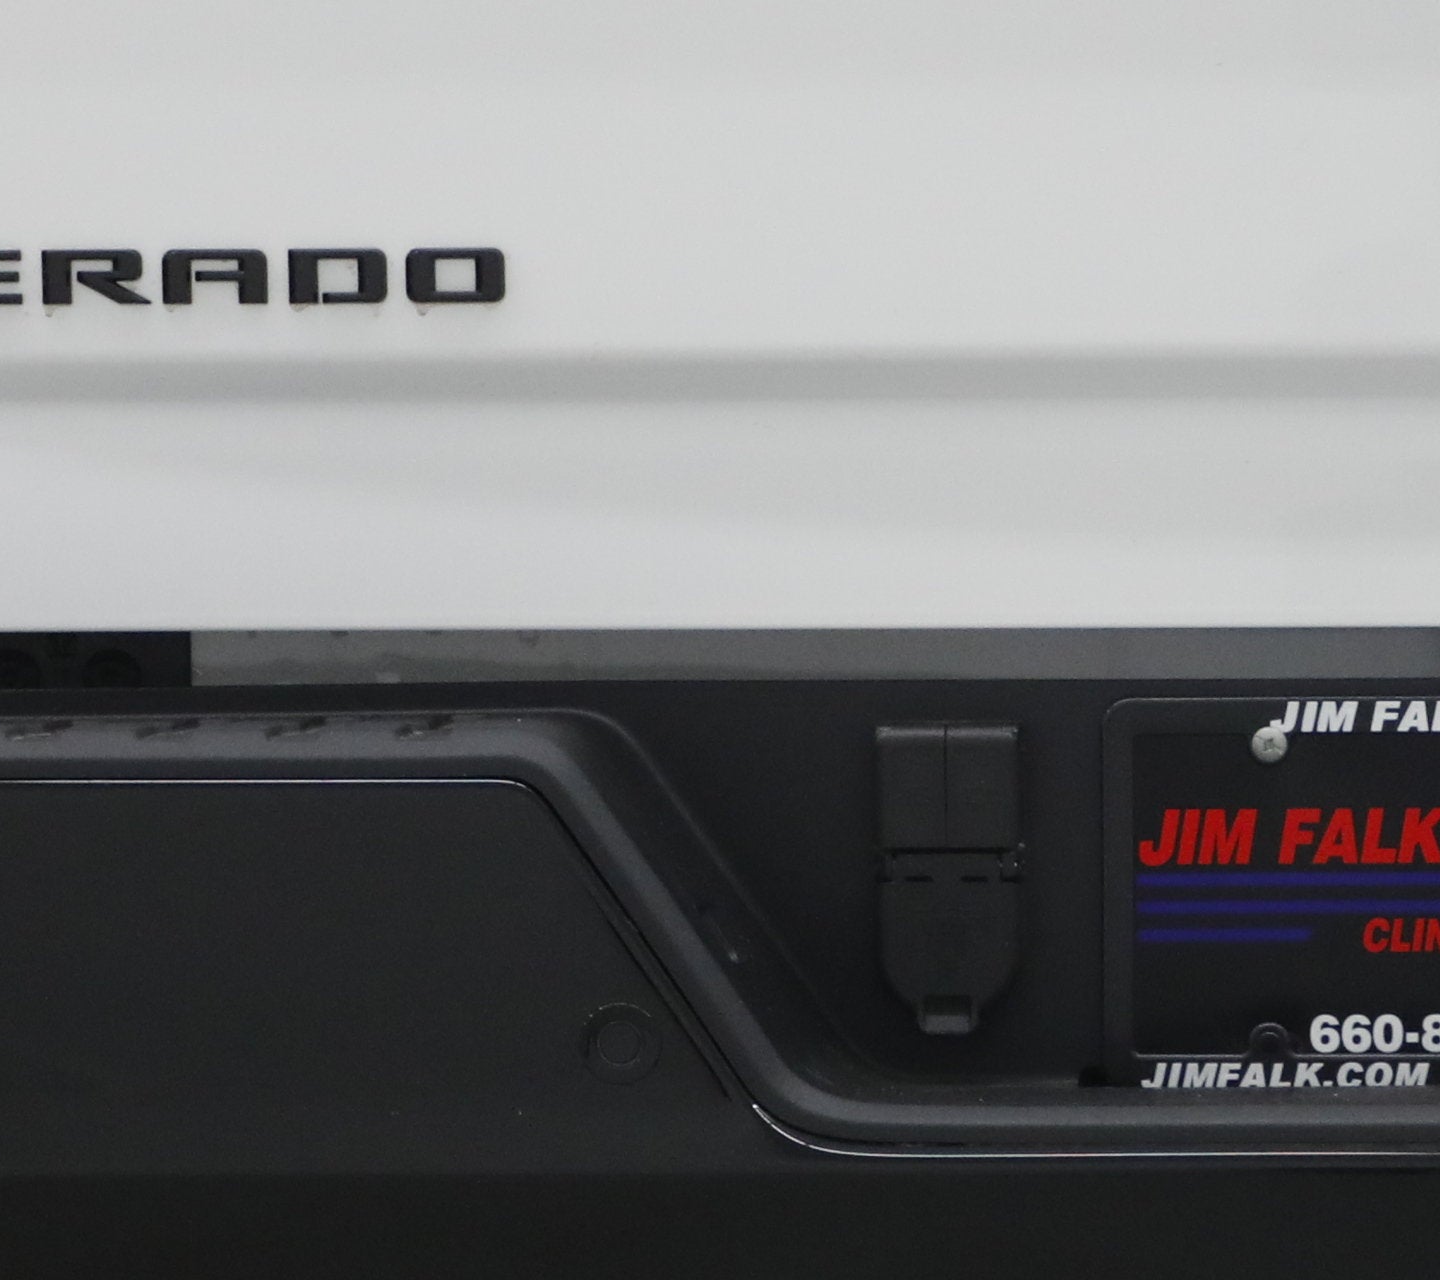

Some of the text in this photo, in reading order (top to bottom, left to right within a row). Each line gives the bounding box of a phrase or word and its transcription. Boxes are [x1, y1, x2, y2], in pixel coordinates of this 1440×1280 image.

[1270, 700, 1359, 733] JIM
[1138, 807, 1259, 867] JIM
[1140, 1061, 1431, 1089] JIMFALK.COM
